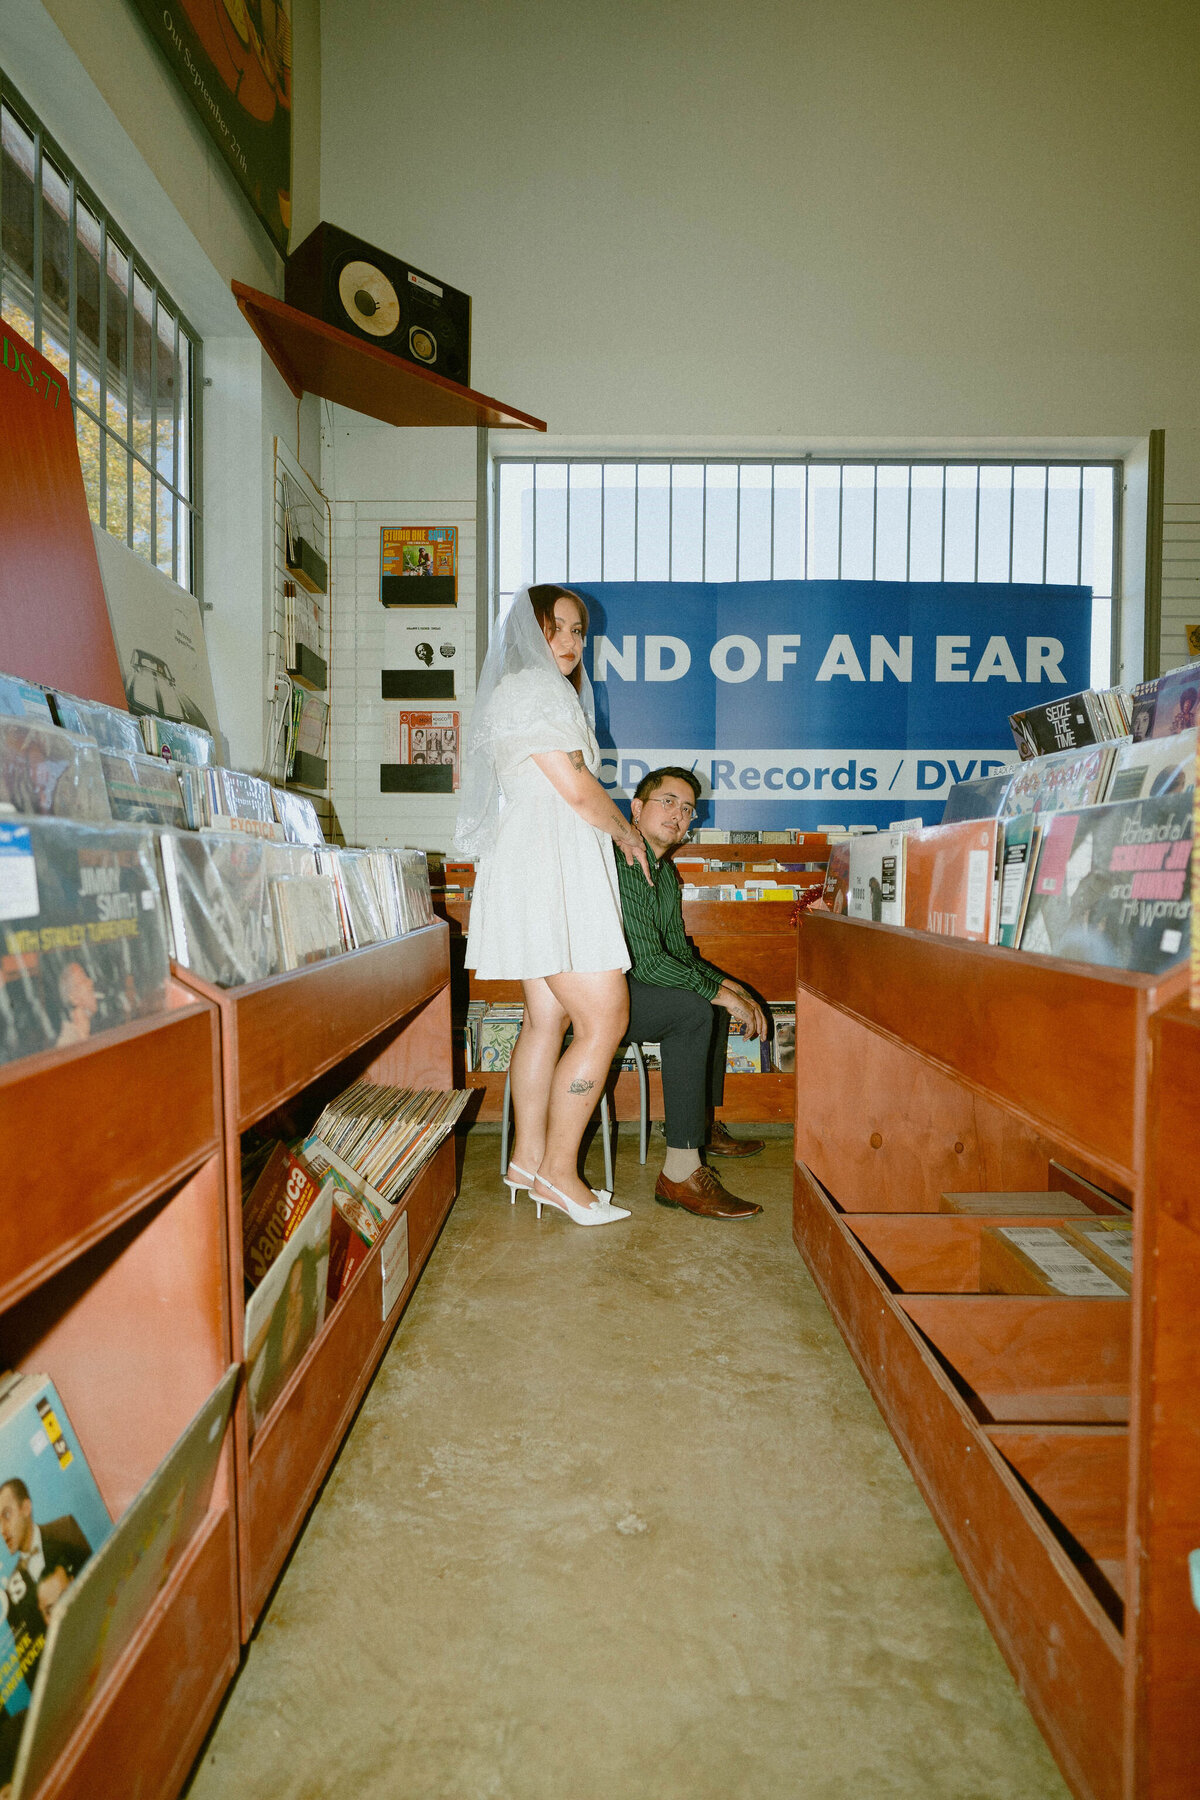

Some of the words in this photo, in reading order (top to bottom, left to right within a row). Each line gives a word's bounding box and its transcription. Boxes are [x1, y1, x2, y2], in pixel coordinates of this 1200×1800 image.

[163, 10, 182, 50] Out
[184, 48, 230, 136] September
[230, 135, 248, 174] 27th
[384, 529, 411, 541] STUDIO
[412, 529, 426, 541] ONE
[428, 529, 446, 541] SOUL
[447, 530, 453, 541] 2
[583, 634, 692, 683] ND
[709, 634, 801, 684] OF
[815, 634, 913, 683] AN
[935, 635, 1067, 684] EAR
[1045, 701, 1072, 722] SEIZE
[1052, 717, 1072, 735] THE
[1054, 731, 1077, 749] TIME
[597, 758, 661, 790] CD
[710, 759, 877, 791] Records
[250, 1167, 308, 1277] Jamaica
